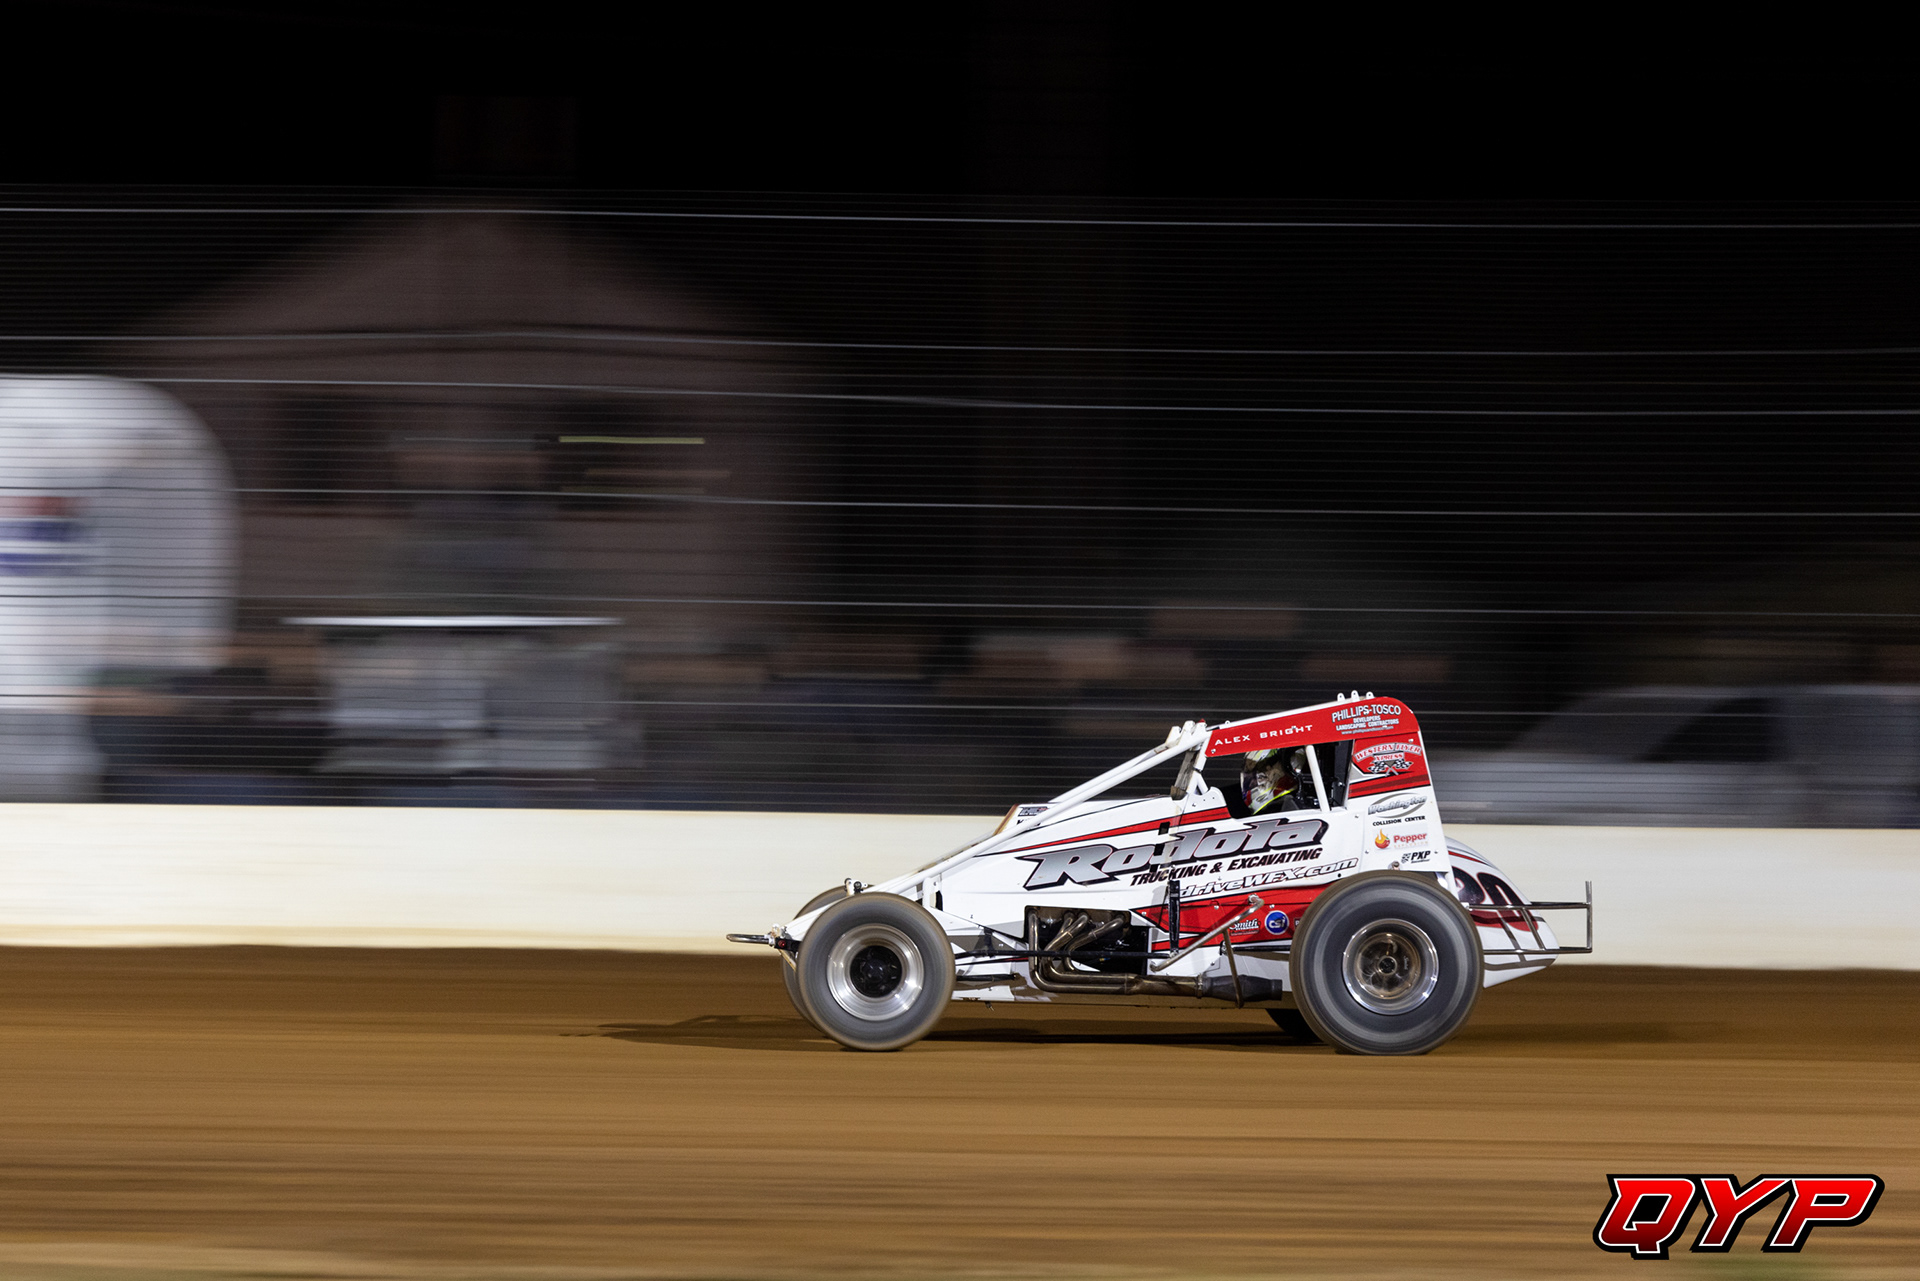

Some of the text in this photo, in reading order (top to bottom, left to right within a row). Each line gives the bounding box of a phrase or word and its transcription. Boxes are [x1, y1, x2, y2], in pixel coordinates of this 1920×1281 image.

[1332, 704, 1401, 722] PHILLIPS-TOSCO
[1215, 725, 1313, 746] ALEX BRIGHT
[1356, 743, 1421, 760] WESTERN FLYER
[1368, 796, 1427, 815] Washington
[1372, 815, 1426, 826] COLLISION CENTER
[1393, 833, 1427, 843] Pepper
[1015, 818, 1329, 891] Rodota
[1411, 850, 1431, 860] PXP
[1130, 848, 1323, 886] TRUCKING & EXCAVATING
[1181, 858, 1359, 898] driveWFX.com
